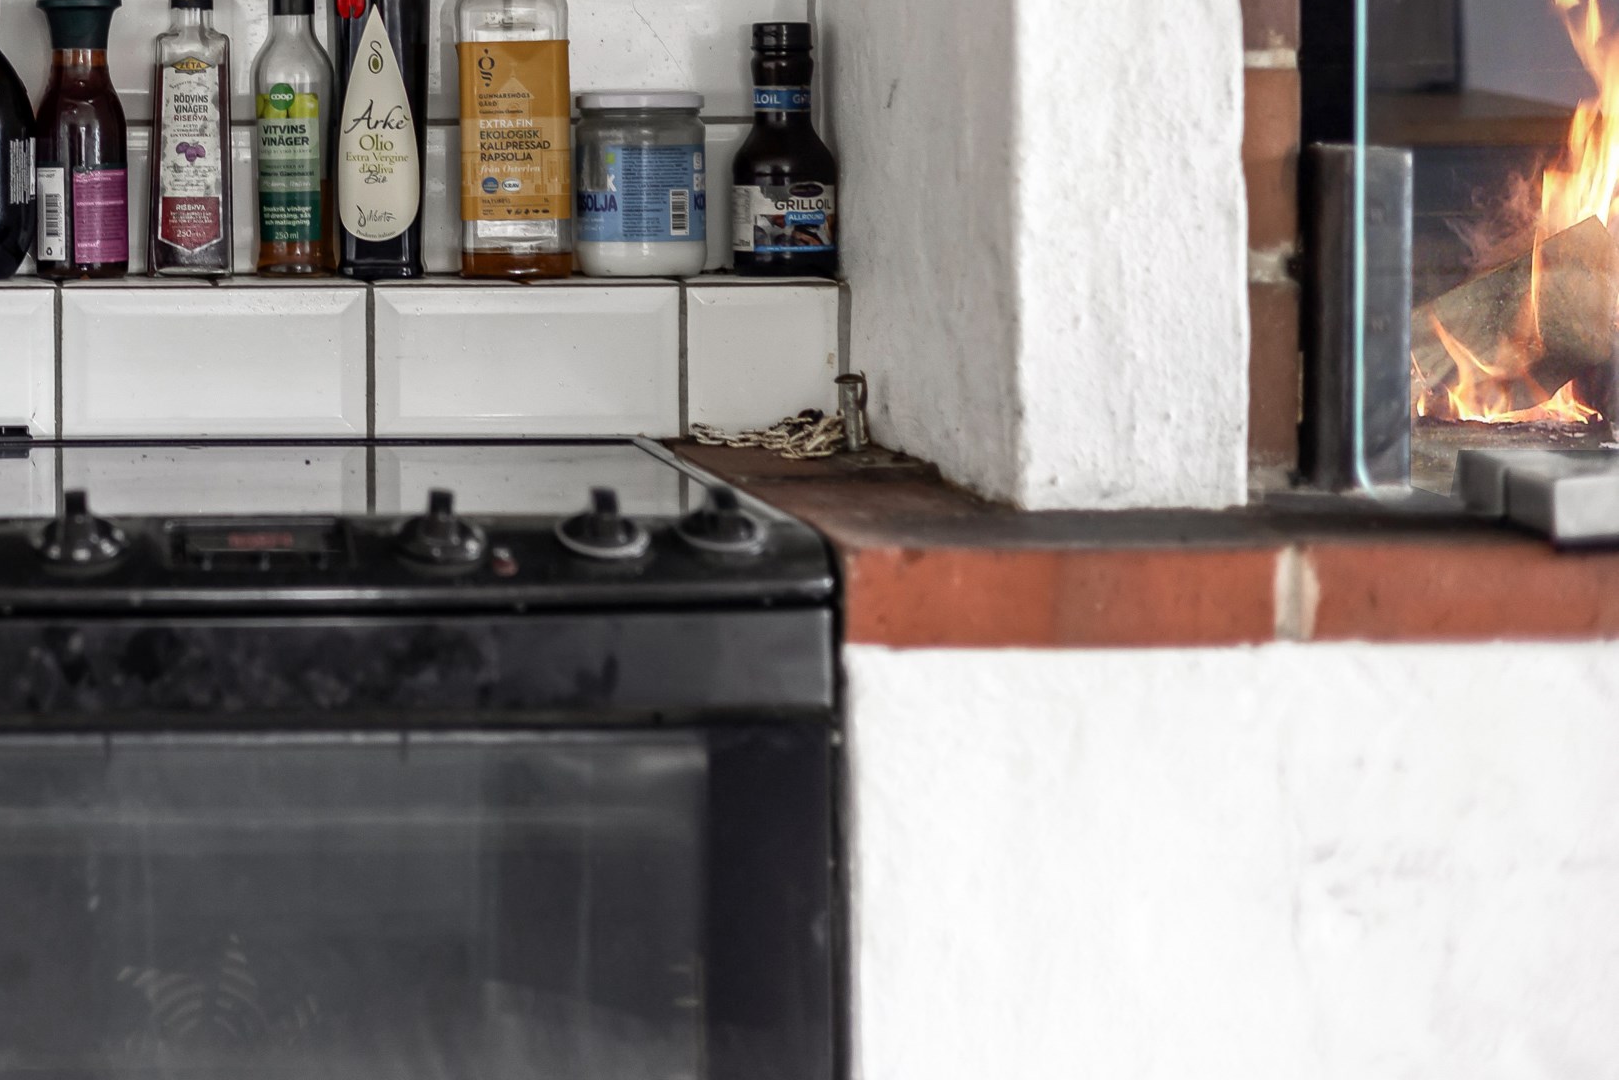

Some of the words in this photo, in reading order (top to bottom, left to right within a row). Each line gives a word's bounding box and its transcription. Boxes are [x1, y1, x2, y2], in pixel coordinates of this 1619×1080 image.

[179, 61, 202, 69] ZETA
[174, 92, 209, 103] RÖDVINS
[271, 93, 293, 101] coop
[174, 103, 209, 114] VINÄGER
[174, 114, 208, 122] RISERVA
[479, 120, 514, 129] EXTRA
[515, 119, 534, 128] FIN
[262, 124, 307, 135] VITVINS
[479, 130, 540, 140] EKOLOGISK
[261, 135, 310, 147] VINÄGER
[359, 134, 394, 151] Olio
[479, 141, 551, 151] KALLPRESSAD
[345, 152, 370, 162] Extra
[372, 152, 409, 165] Vergine
[479, 152, 534, 162] RAPSOLJA
[479, 164, 500, 174] från
[502, 163, 541, 174] Österlen
[175, 203, 206, 211] RISERVA
[774, 198, 832, 211] GRILLOIL
[275, 231, 289, 240] 250
[290, 231, 299, 239] ml
